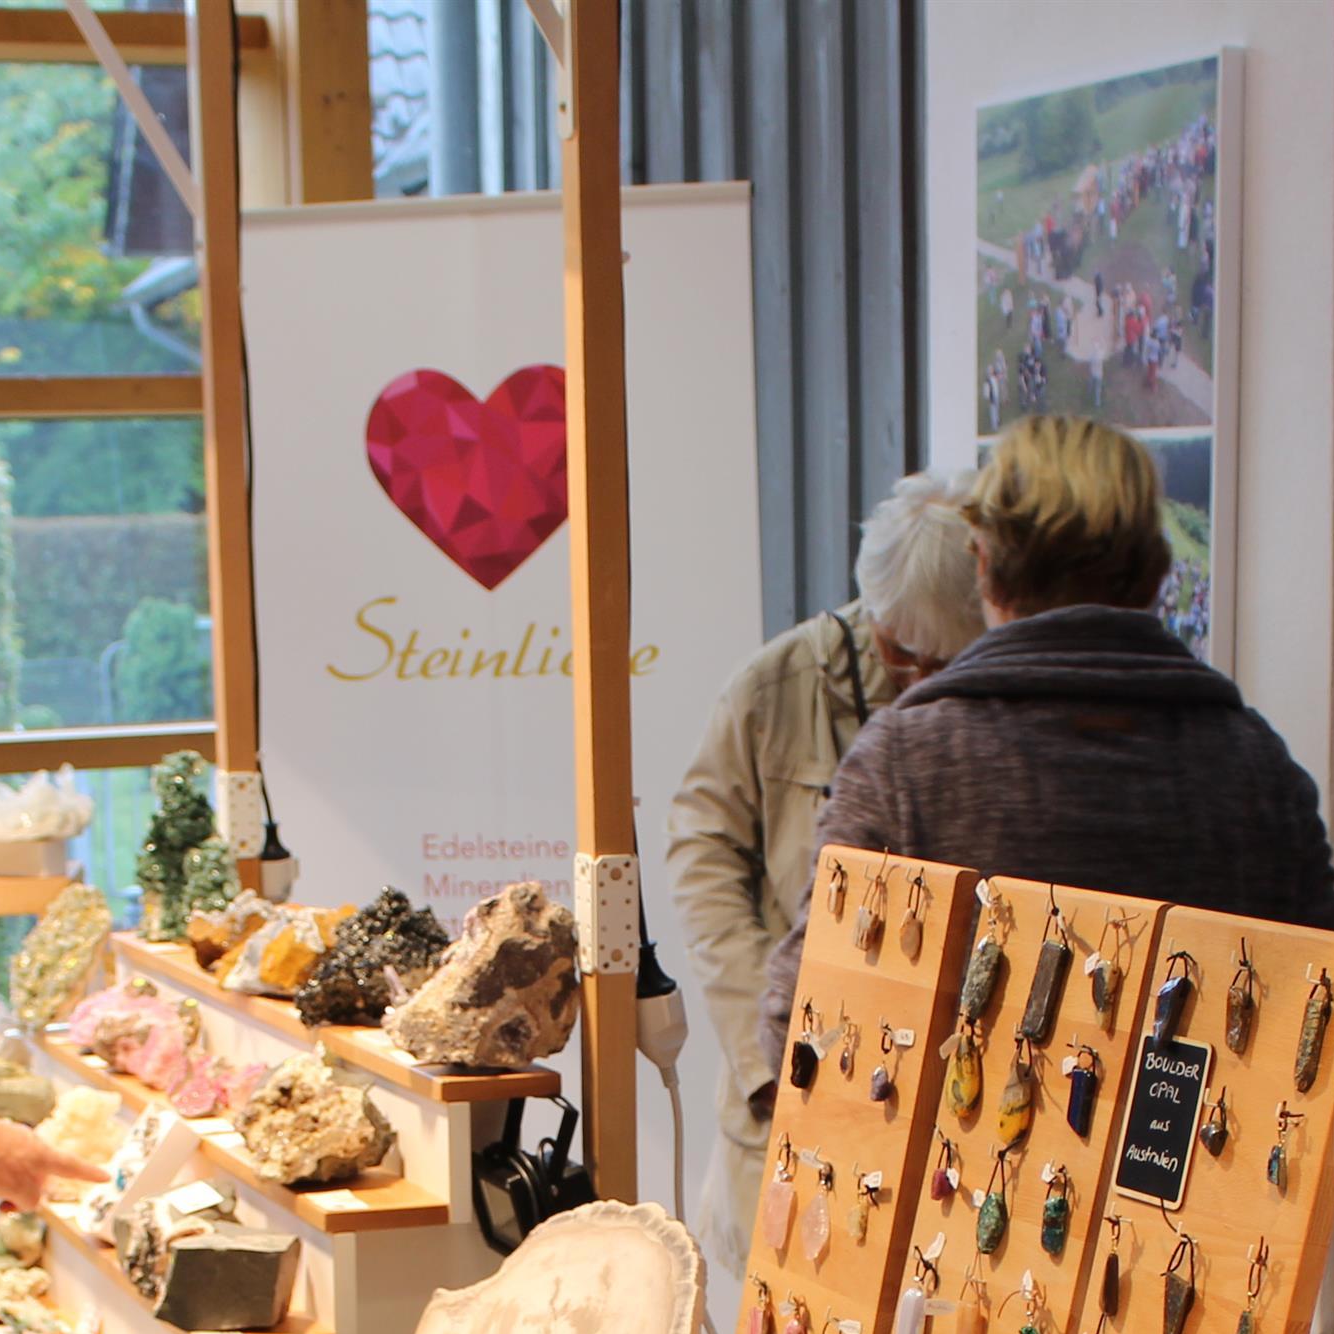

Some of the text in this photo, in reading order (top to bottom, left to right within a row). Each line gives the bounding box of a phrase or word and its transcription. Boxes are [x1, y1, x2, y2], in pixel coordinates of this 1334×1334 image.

[325, 596, 660, 682] Steinlie
[421, 831, 570, 860] Edelsteine
[1145, 1052, 1200, 1081] BOULDER
[1149, 1119, 1171, 1132] aus
